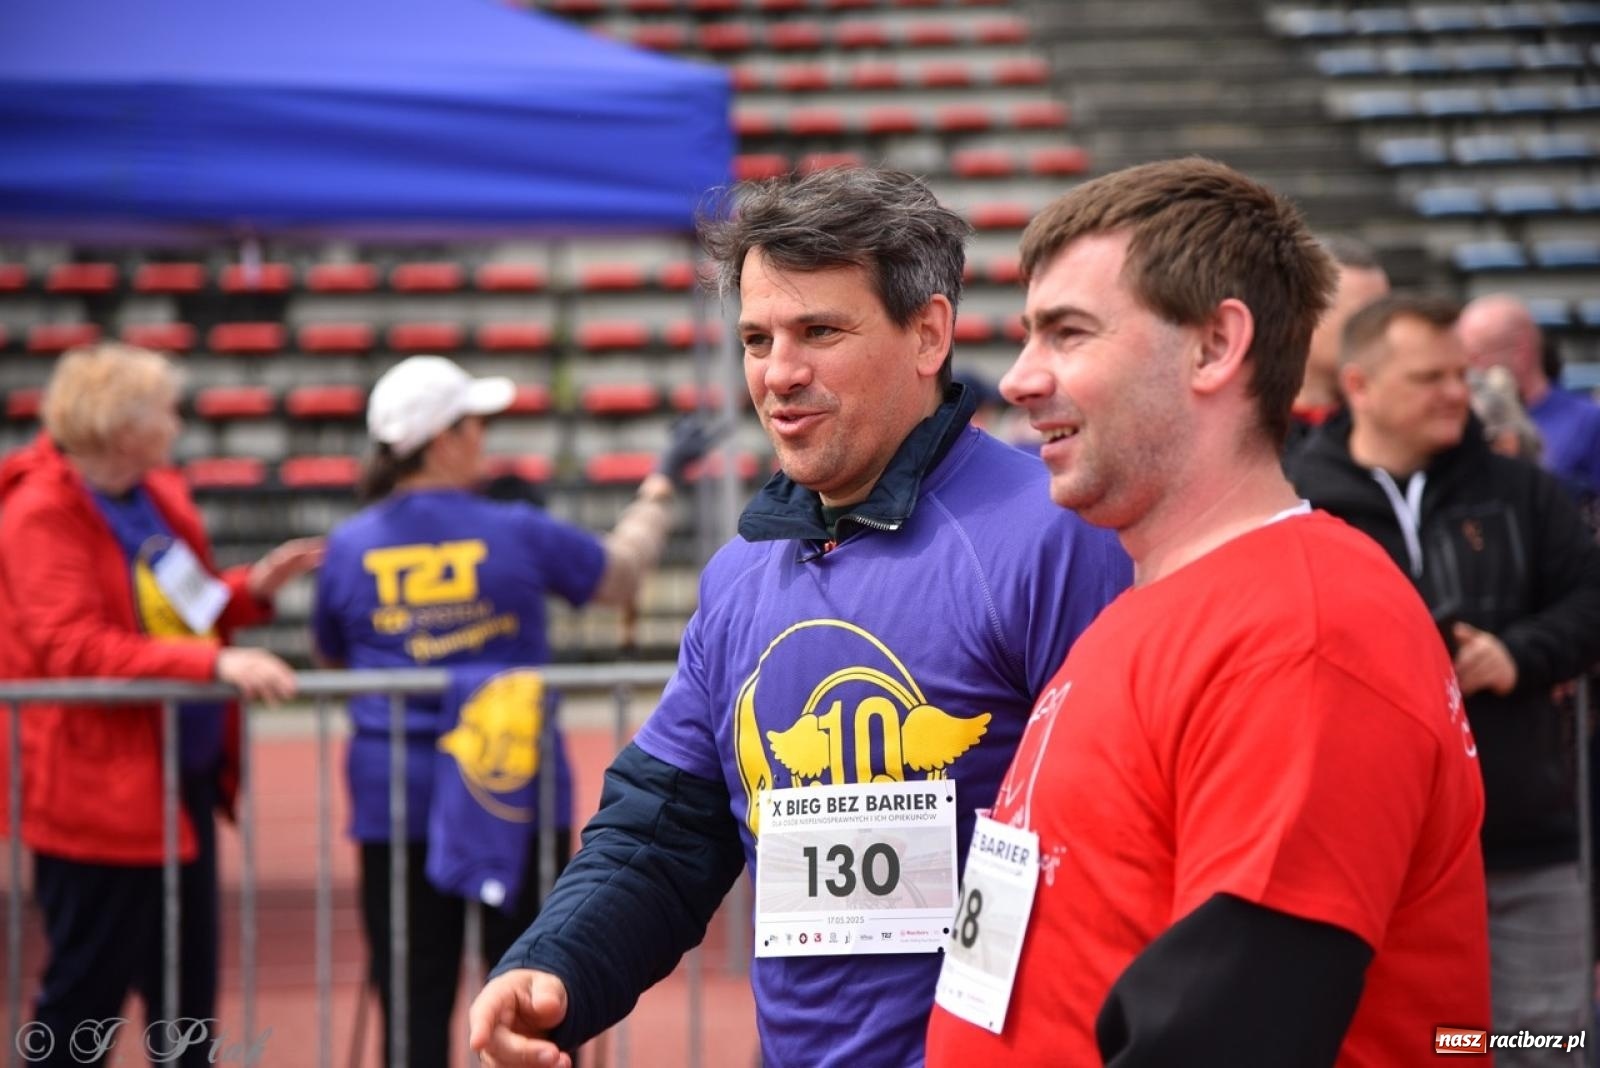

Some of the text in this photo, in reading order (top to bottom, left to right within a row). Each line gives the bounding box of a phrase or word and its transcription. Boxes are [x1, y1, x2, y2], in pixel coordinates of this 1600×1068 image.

[363, 540, 487, 606] T2T
[772, 793, 938, 817] X BIEG BEZ BARIER
[888, 812, 937, 821] OPIEKUNÓW
[979, 833, 1031, 867] BARIER
[803, 843, 900, 897] 130
[828, 915, 865, 924] 17.05.2025
